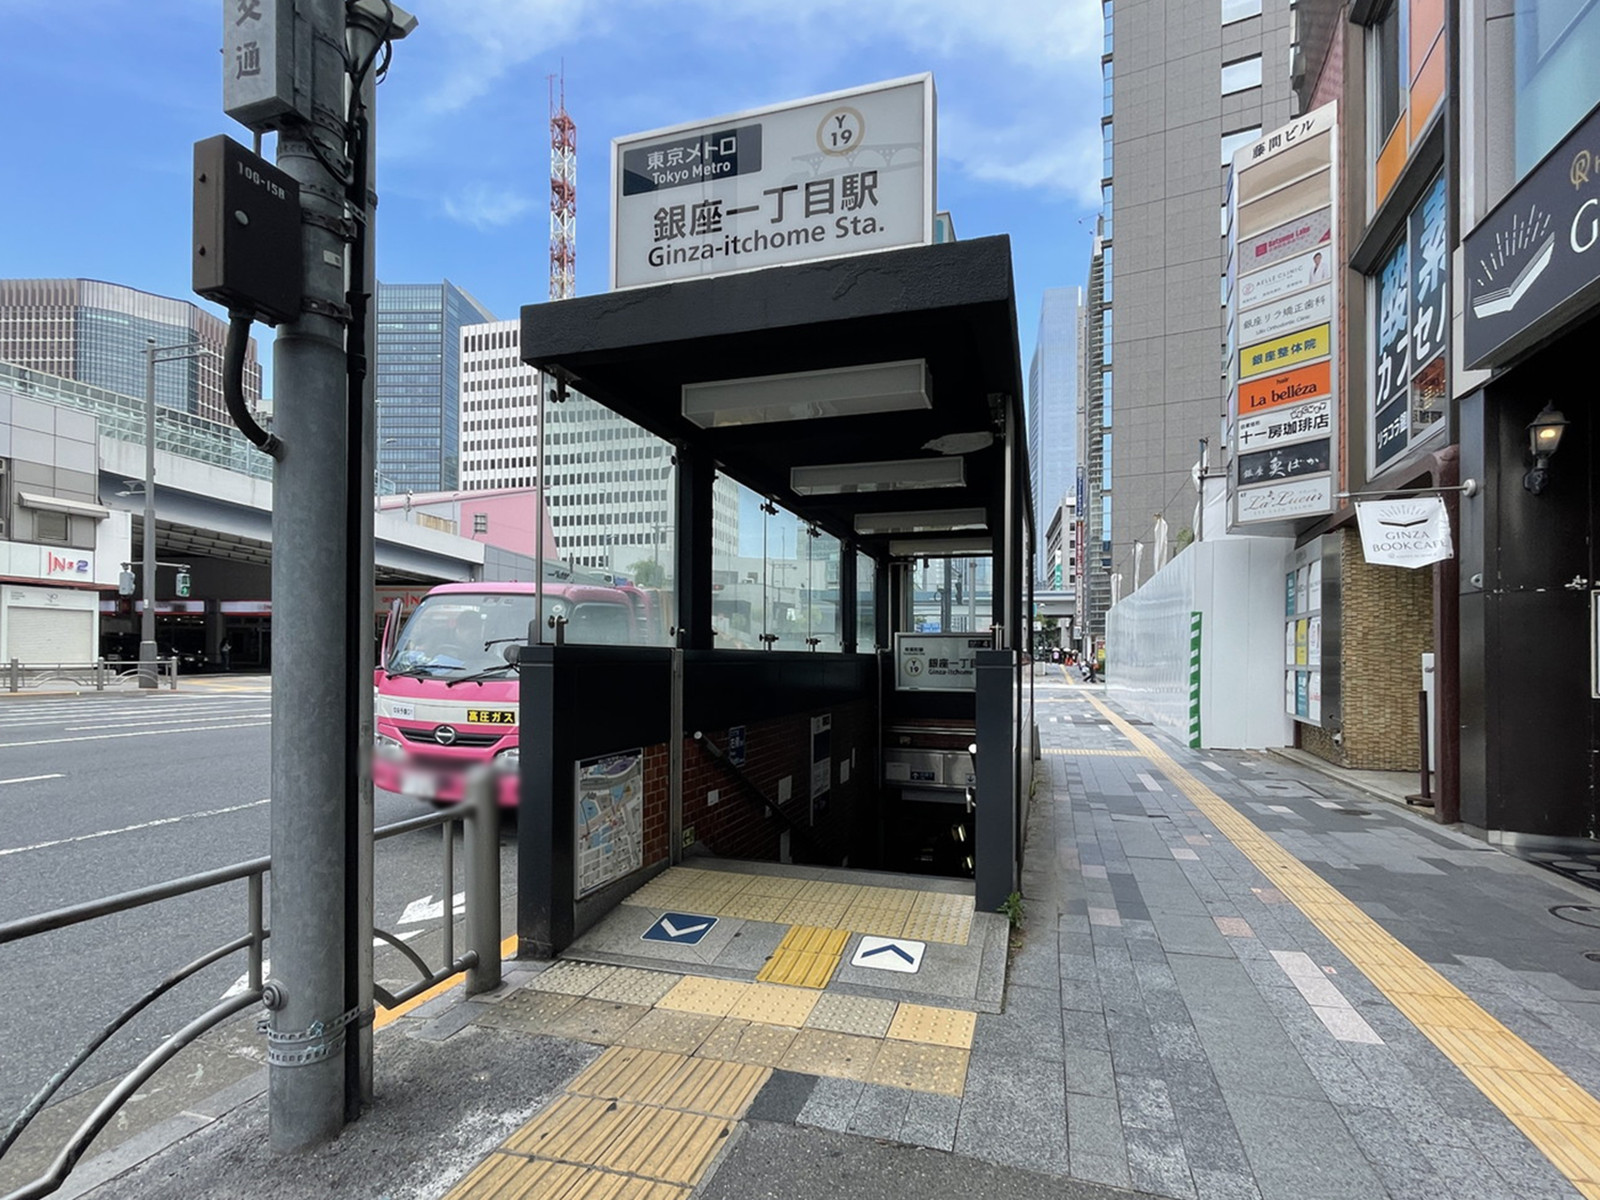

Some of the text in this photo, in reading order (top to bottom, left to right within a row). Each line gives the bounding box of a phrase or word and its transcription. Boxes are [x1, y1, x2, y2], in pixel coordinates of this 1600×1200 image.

[236, 0, 262, 80] 交通
[835, 114, 847, 129] Y
[831, 129, 853, 148] 19
[647, 136, 737, 171] 東京メトロ
[652, 160, 731, 186] Tokyo Metro
[653, 170, 879, 242] 銀座一丁目駅
[648, 216, 885, 268] Ginza-itchome Sta.
[1252, 338, 1317, 366] 銀座整体院
[1250, 383, 1317, 408] La belléza
[1240, 413, 1329, 444] 十一房珈琲店
[1372, 541, 1412, 552] BOOK
[1385, 530, 1430, 540] GINZA
[468, 711, 515, 723] 高圧ガス
